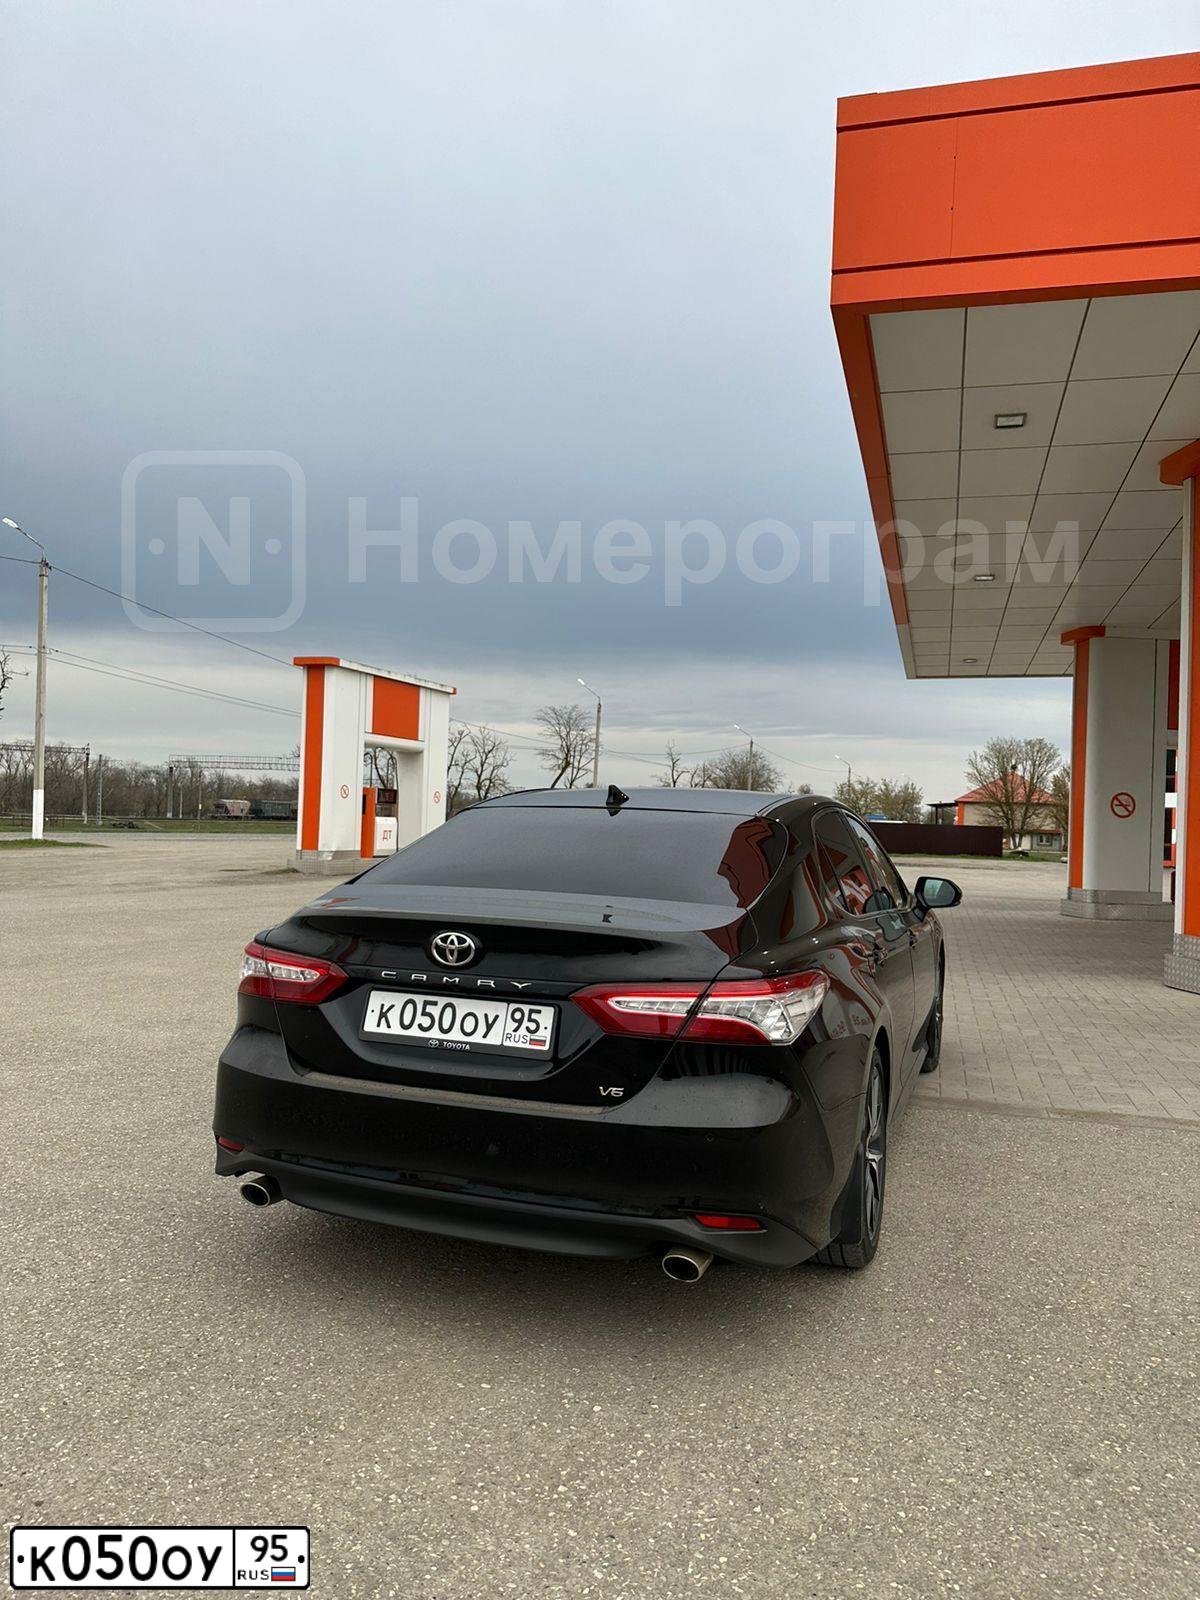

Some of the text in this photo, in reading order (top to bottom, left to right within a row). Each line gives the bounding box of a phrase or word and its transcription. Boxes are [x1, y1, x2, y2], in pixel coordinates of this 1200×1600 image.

[381, 971, 532, 989] CAMRY
[511, 1007, 542, 1034] 95
[505, 1033, 528, 1044] RUS
[443, 1041, 470, 1051] TOYOTA
[599, 1086, 624, 1097] V6
